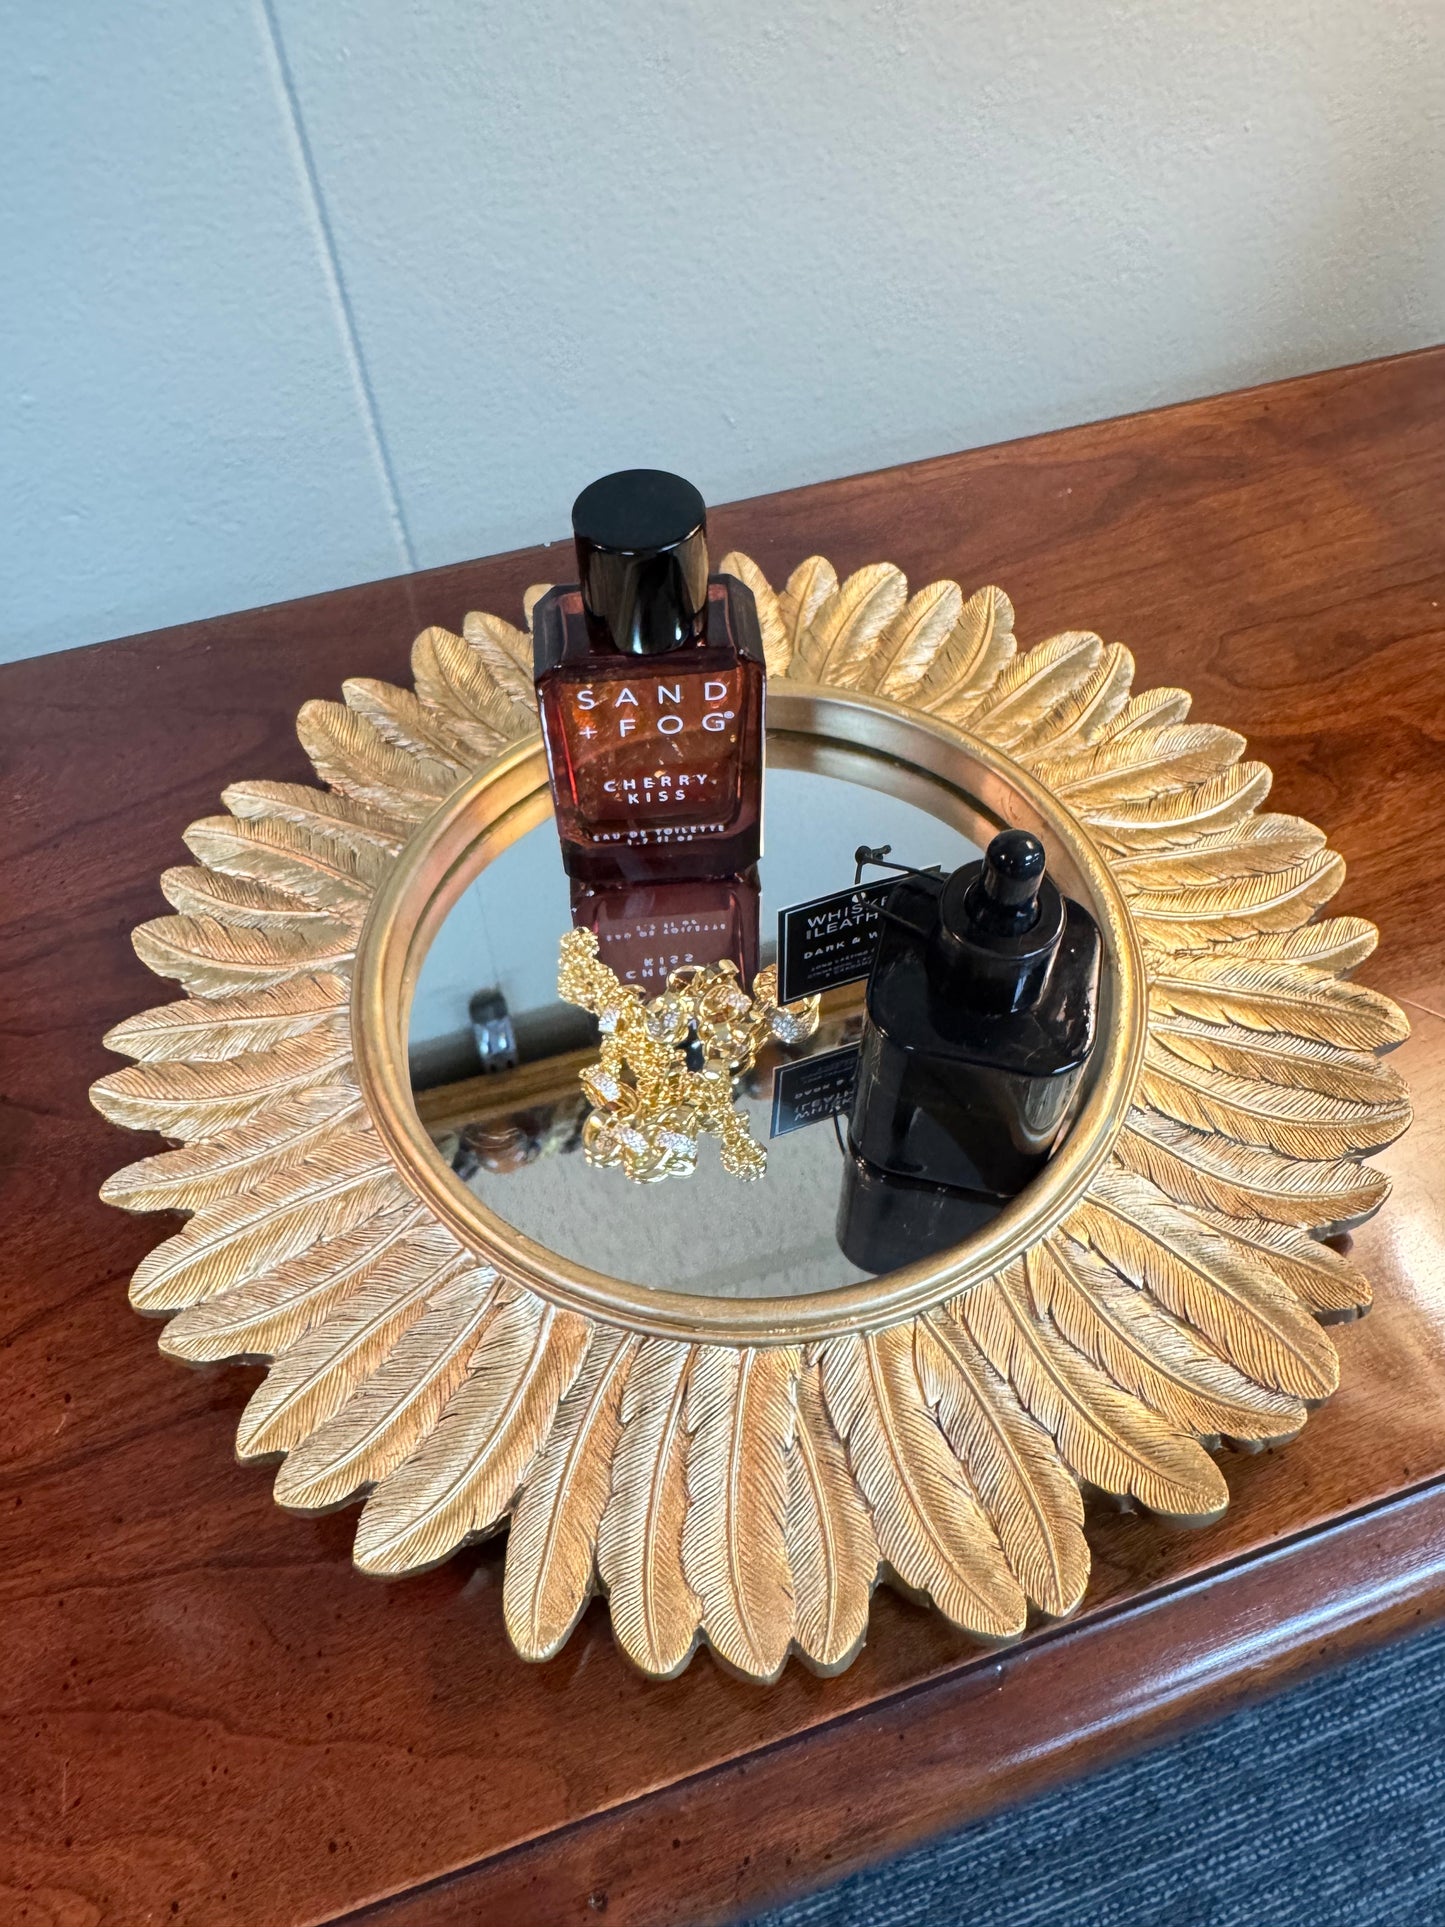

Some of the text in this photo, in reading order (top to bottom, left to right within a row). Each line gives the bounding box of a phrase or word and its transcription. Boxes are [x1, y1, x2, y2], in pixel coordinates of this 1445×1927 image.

[576, 681, 728, 710] SAND
[603, 774, 708, 792] CHERRY
[628, 789, 686, 804] KISS
[807, 896, 888, 928] WHIS
[814, 912, 879, 938] LEATH
